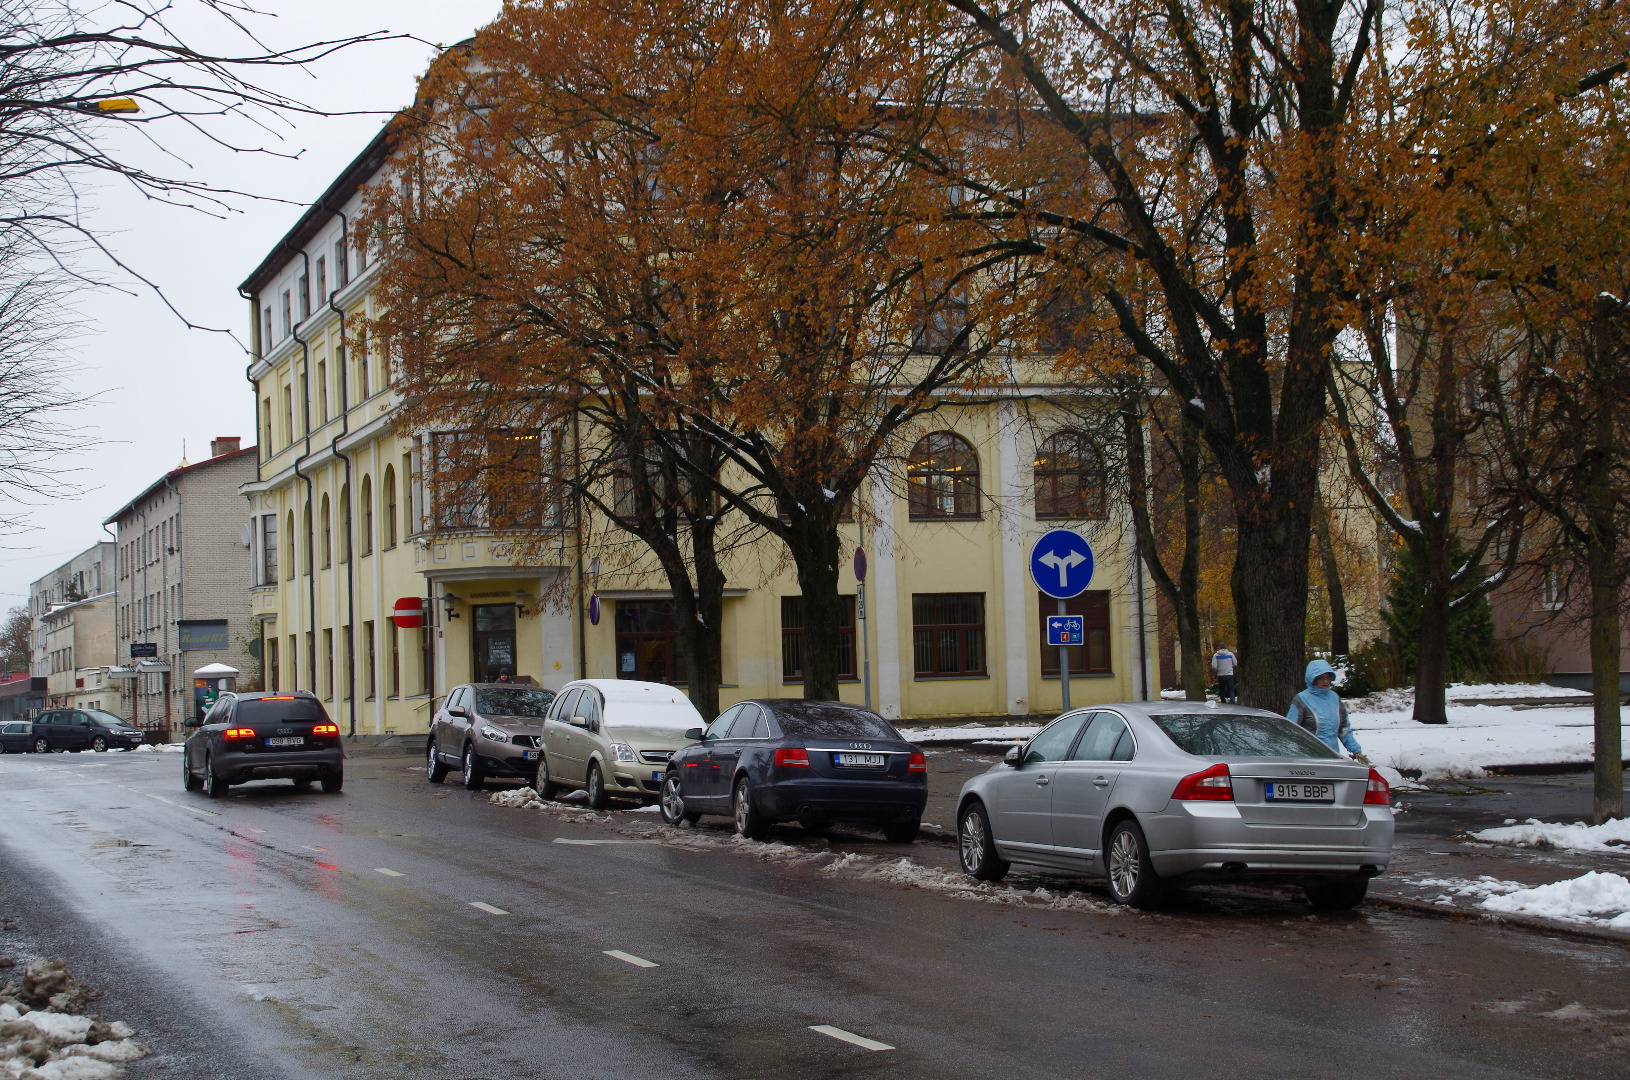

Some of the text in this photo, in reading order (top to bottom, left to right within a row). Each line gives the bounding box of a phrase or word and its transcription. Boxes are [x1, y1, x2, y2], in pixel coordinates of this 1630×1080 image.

[843, 754, 881, 764] 131 MJJ
[1277, 785, 1298, 797] 915
[1303, 785, 1328, 798] BBP
